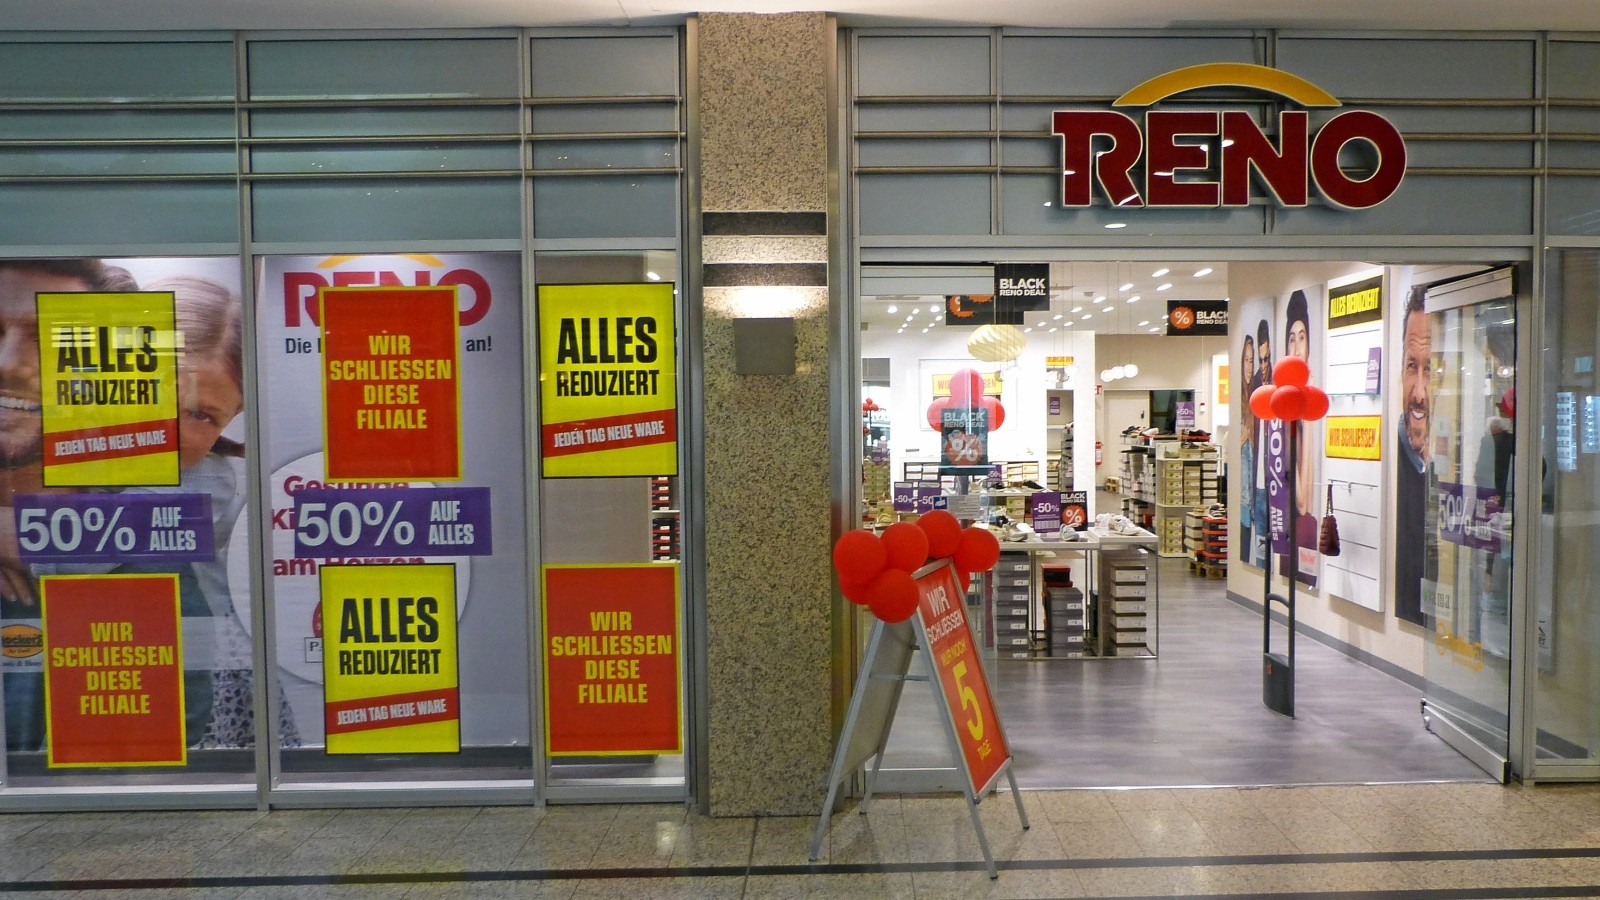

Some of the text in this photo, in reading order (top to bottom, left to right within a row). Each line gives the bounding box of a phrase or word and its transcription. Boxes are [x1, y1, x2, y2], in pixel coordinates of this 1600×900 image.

[1052, 110, 1407, 210] RENO
[1000, 278, 1046, 289] BLACK
[284, 269, 492, 328] RO
[57, 326, 158, 373] ALLES
[285, 338, 312, 354] Die
[369, 335, 411, 355] WIR
[466, 336, 492, 352] an!
[557, 316, 657, 364] ALLES
[330, 360, 451, 381] SCHLIESSEN
[56, 379, 160, 405] REDUZIERT
[556, 369, 660, 397] REDUZIERT
[364, 384, 419, 405] DIESE
[357, 409, 427, 430] FILIALE
[943, 411, 985, 422] BLACK
[55, 430, 167, 456] JEDEN TAG NEUE WARE
[554, 419, 665, 448] JEDEN TAG NEUE WARE
[152, 507, 181, 528] AUF
[430, 500, 460, 522] AUF
[1034, 502, 1060, 513] -50%
[19, 507, 136, 551] 50%
[297, 501, 415, 546] 50%
[150, 530, 196, 551] ALLES
[428, 524, 475, 545] ALLES
[273, 558, 316, 576] am
[927, 586, 950, 617] WIR
[339, 597, 439, 644] ALLES
[590, 611, 632, 632] WIR
[927, 608, 964, 644] SCHLIESSEN
[90, 622, 133, 642] WIR
[552, 635, 672, 656] SCHLIESSEN
[52, 646, 173, 667] SCHLIESSEN
[339, 649, 441, 676] REDUZIERT
[585, 659, 640, 680] DIESE
[87, 670, 142, 691] DIESE
[578, 683, 648, 704] FILIALE
[953, 660, 984, 740] 5
[80, 694, 150, 715] FILIALE
[337, 698, 447, 725] JEDEN TAG NEUE WARE
